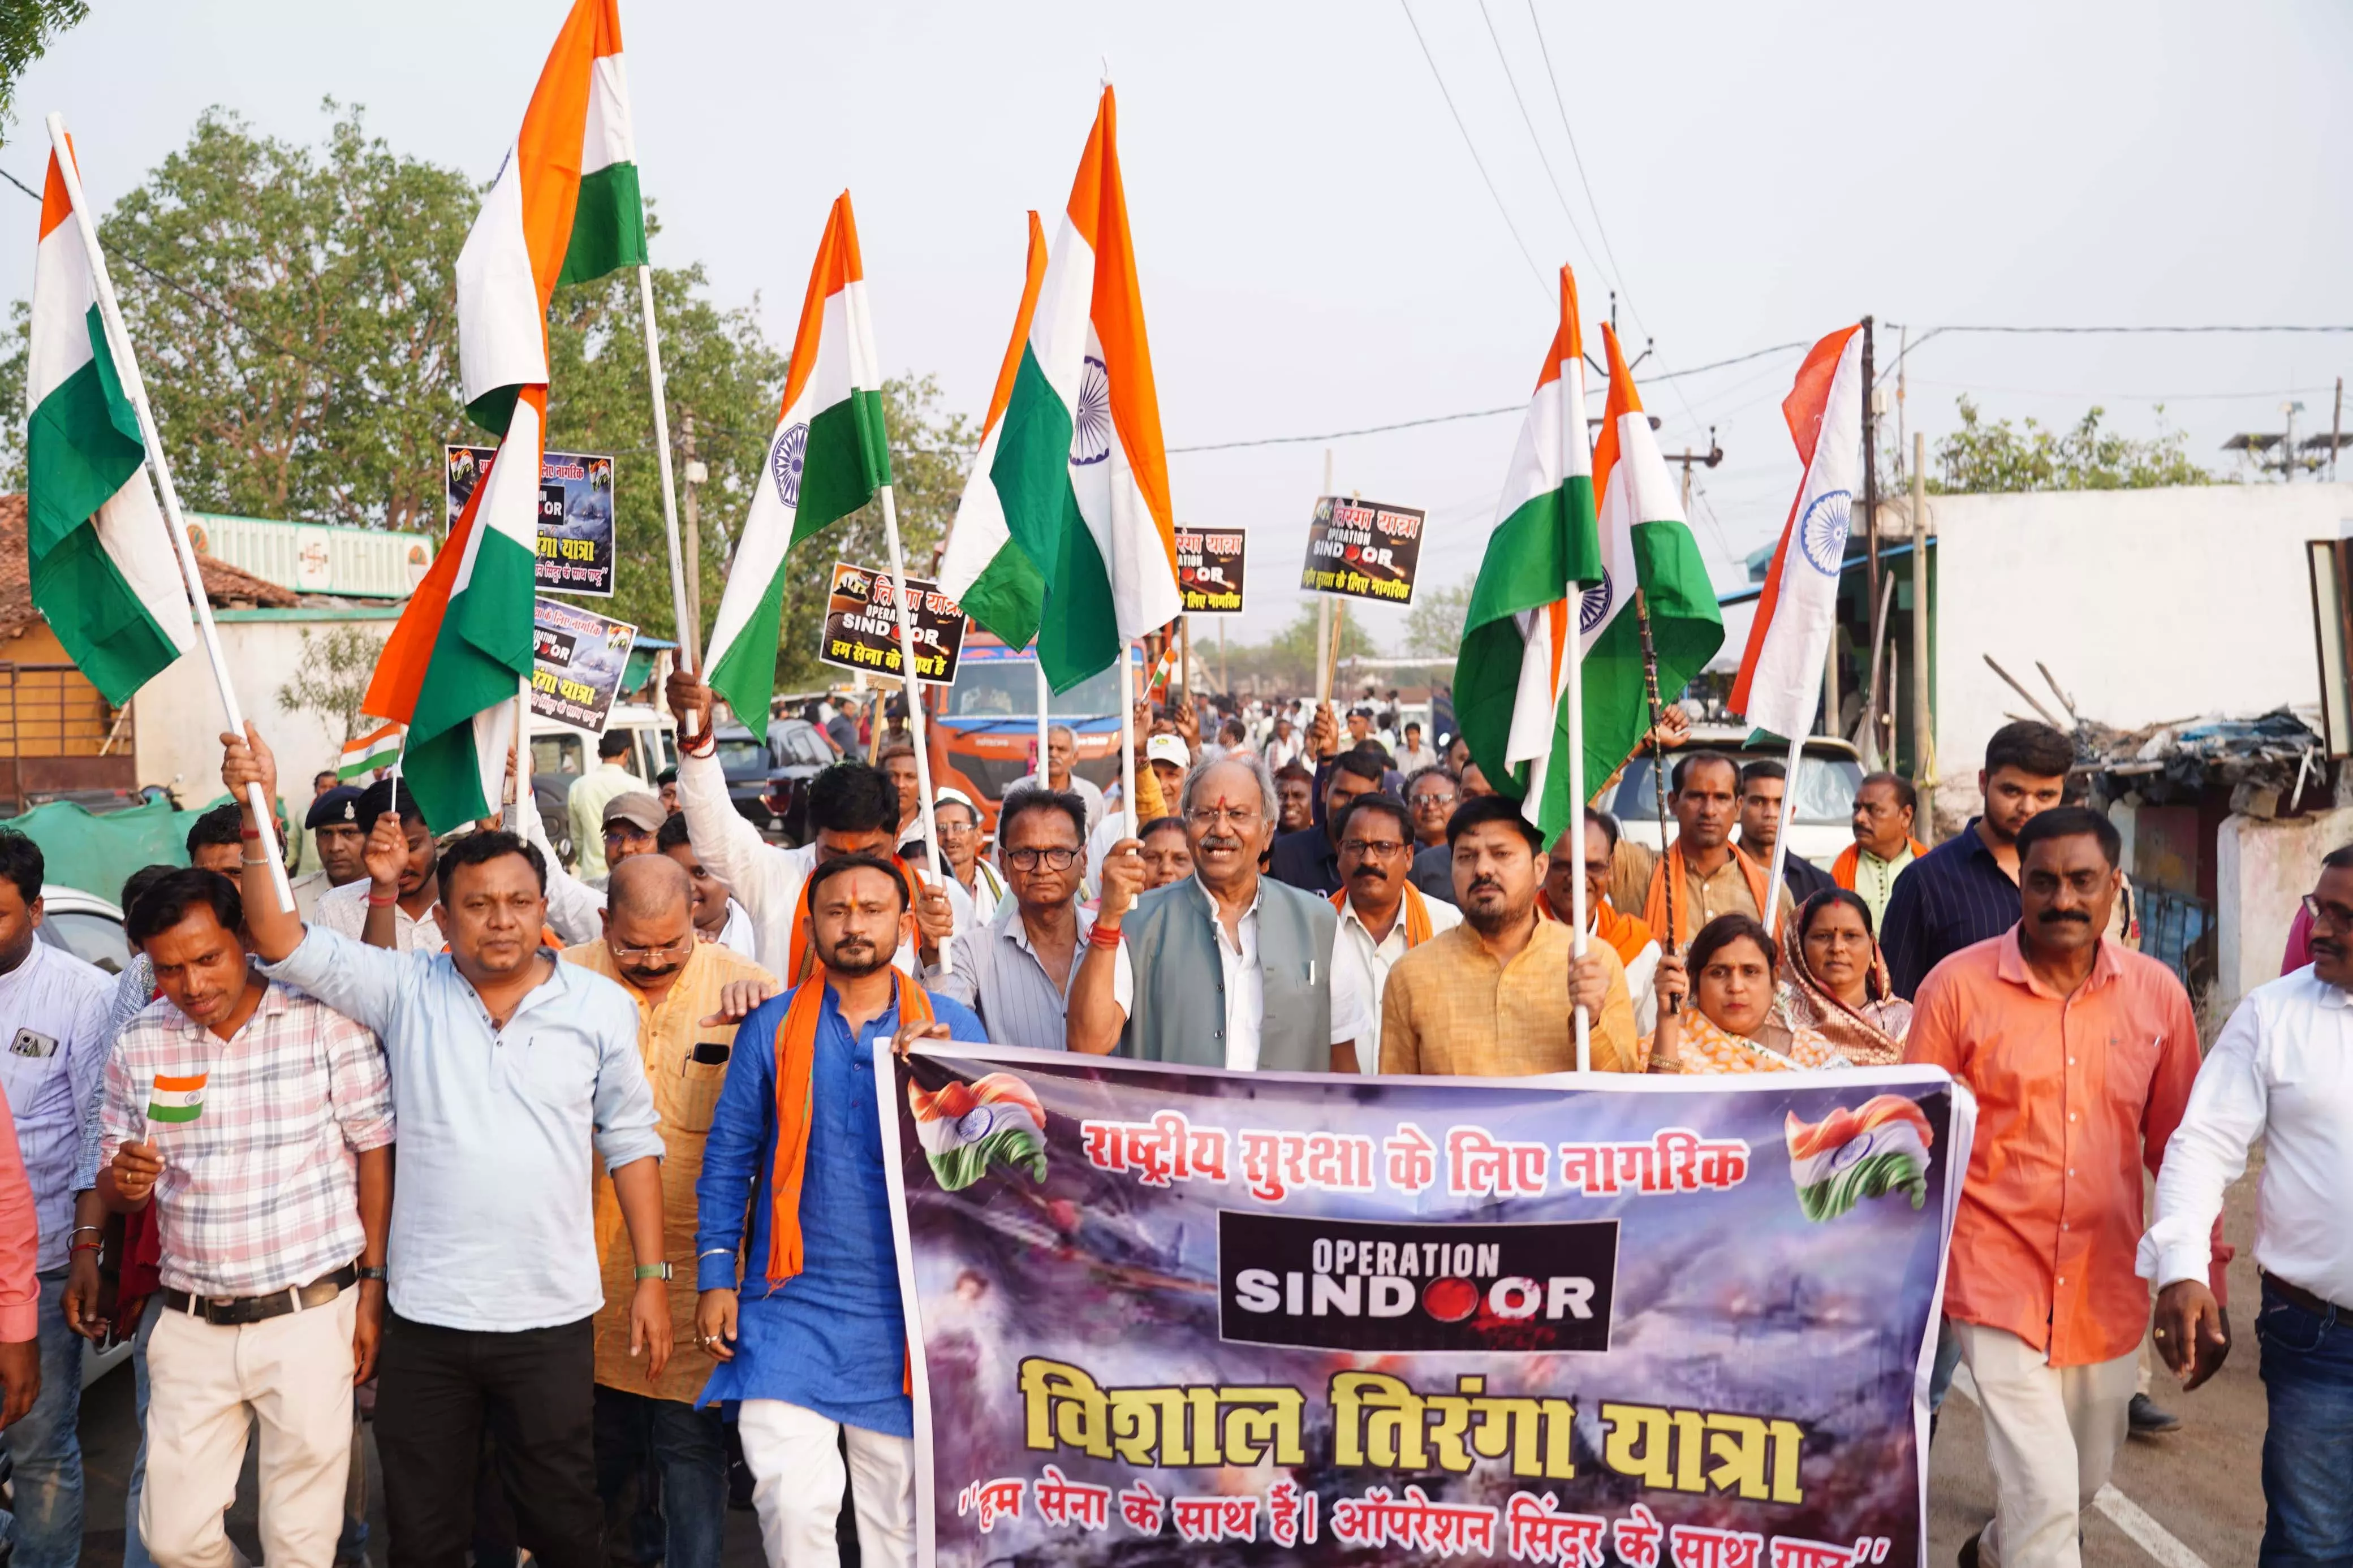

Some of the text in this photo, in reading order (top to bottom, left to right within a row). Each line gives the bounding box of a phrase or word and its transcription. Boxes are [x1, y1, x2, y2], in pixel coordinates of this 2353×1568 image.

[555, 463, 584, 481] नागरिक
[1332, 498, 1420, 539] तिरंगा यात्रा
[562, 538, 594, 561] यात्रा
[1205, 534, 1243, 555] यात्रा
[1328, 528, 1371, 546] OPERATION
[562, 563, 571, 579] के
[572, 567, 587, 581] साथ
[1178, 554, 1203, 567] ATION
[1335, 569, 1347, 589] के
[1348, 572, 1369, 593] लिए
[1372, 578, 1410, 598] नागरिक
[1187, 590, 1206, 609] लिए
[1208, 591, 1241, 608] नागरिक
[831, 640, 852, 659] हम
[853, 642, 884, 666] सेना
[885, 648, 902, 668] के
[934, 655, 947, 676] है
[561, 679, 596, 706] यात्रा
[1081, 1110, 1751, 1204] राष्ट्रीय सुरक्षा के लिए नागरिक
[1312, 1238, 1499, 1277] OPERATION
[1235, 1268, 1595, 1322] SINDOOR
[1018, 1357, 1805, 1506] विशाल तिरंगा यात्रा
[1033, 1464, 1112, 1531] सेना
[1119, 1478, 1164, 1536] के
[1172, 1496, 1259, 1544] साथ
[1330, 1484, 1499, 1558] ऑपरेशन
[1614, 1502, 1664, 1568] के
[1670, 1523, 1764, 1568] साथ
